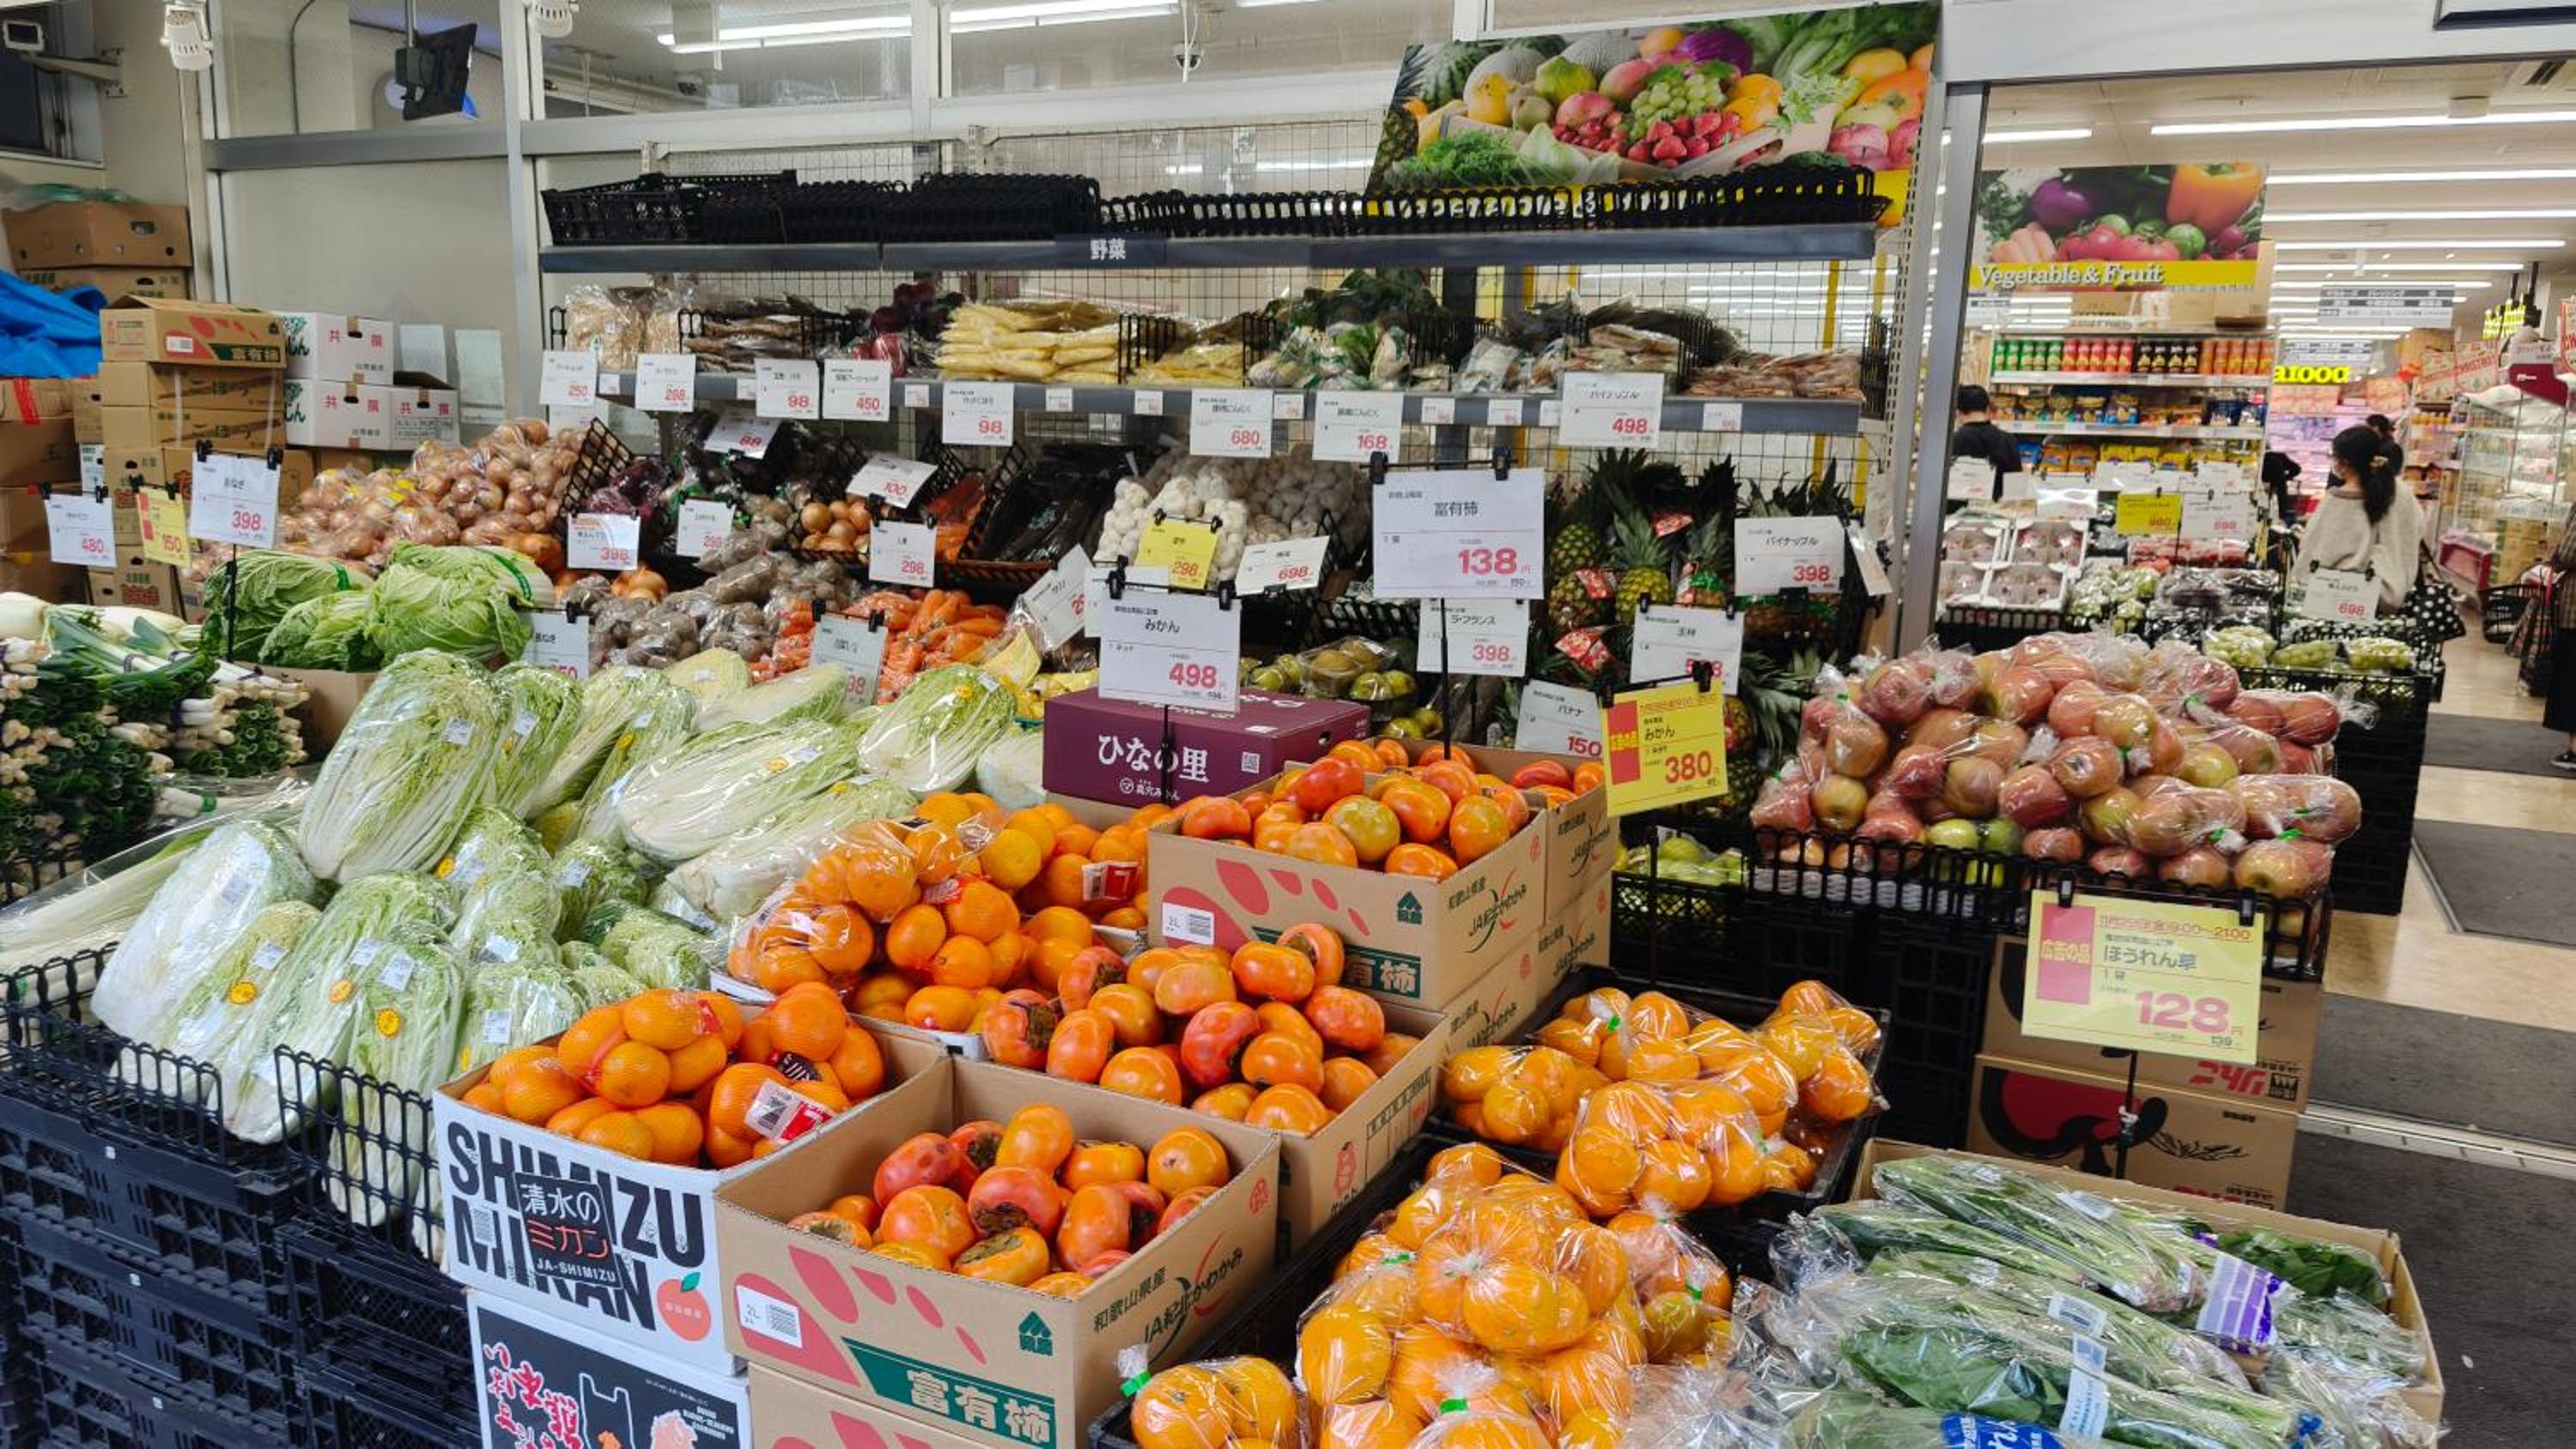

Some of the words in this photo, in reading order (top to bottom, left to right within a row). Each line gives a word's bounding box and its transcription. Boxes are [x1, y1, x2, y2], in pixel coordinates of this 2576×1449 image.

[1090, 238, 1127, 260] 野菜
[1978, 263, 2080, 288] Vegetable
[2084, 266, 2099, 284] &
[2105, 264, 2164, 283] Fruit
[978, 420, 1003, 434] 98
[1612, 418, 1649, 433] 498
[1230, 430, 1261, 446] 680
[1357, 434, 1388, 450] 168
[1434, 501, 1479, 517] 富有柿
[233, 511, 262, 531] 398
[82, 537, 104, 554] 480
[901, 560, 925, 575] 298
[1457, 547, 1518, 575] 138
[1278, 566, 1309, 581] 698
[1793, 565, 1830, 582] 398
[1145, 618, 1181, 634] みかん
[1473, 644, 1510, 662] 398
[1169, 662, 1218, 688] 498
[1567, 736, 1602, 757] 150
[1097, 734, 1210, 784] ひなの里
[1664, 749, 1712, 784] 380
[2103, 945, 2198, 970] ほうれん草
[2135, 990, 2230, 1034] 128
[520, 1183, 600, 1224] 清水の
[527, 1220, 610, 1259] ミカン
[537, 1258, 617, 1282] JA-SHIMIZU
[906, 1369, 1053, 1443] 富有柿
